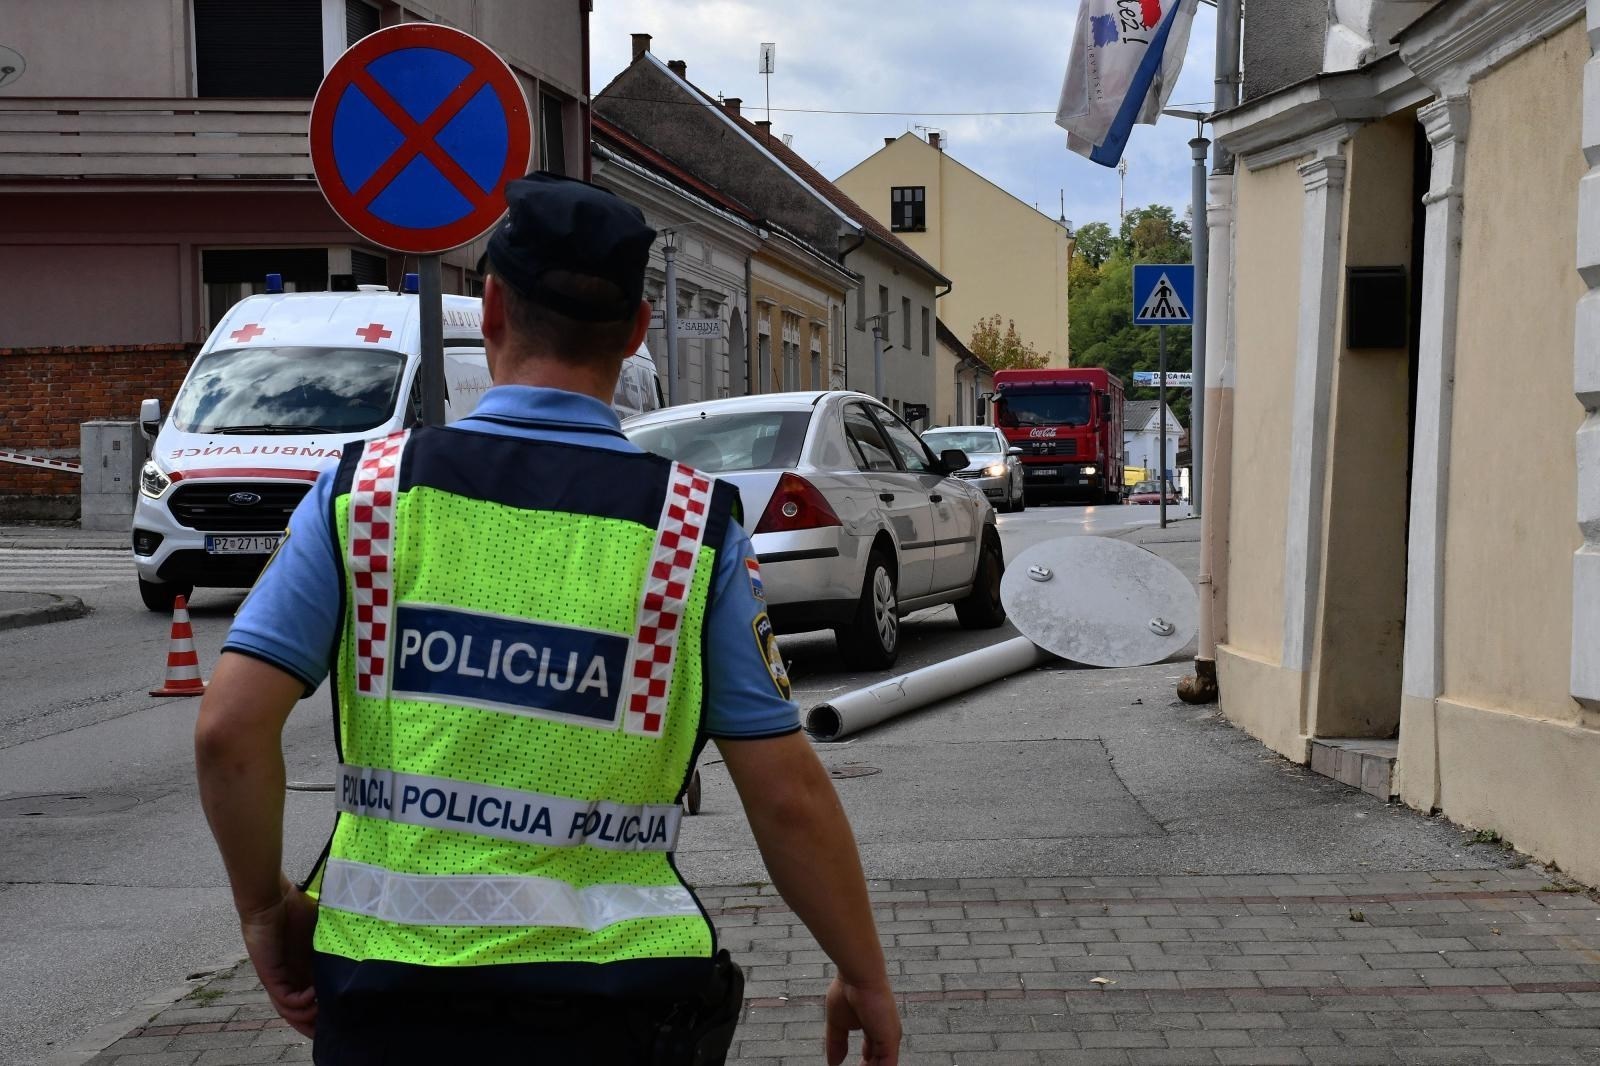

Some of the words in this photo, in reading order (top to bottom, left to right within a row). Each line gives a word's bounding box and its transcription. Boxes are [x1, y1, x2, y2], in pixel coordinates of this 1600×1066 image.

[443, 311, 482, 328] AMBUL
[685, 322, 719, 332] SABINA
[214, 538, 229, 550] PZ
[400, 629, 610, 698] POLICIJA
[343, 774, 393, 810] POLICIJ
[402, 785, 552, 837] POLICIJA
[568, 811, 667, 843] POLICJA
